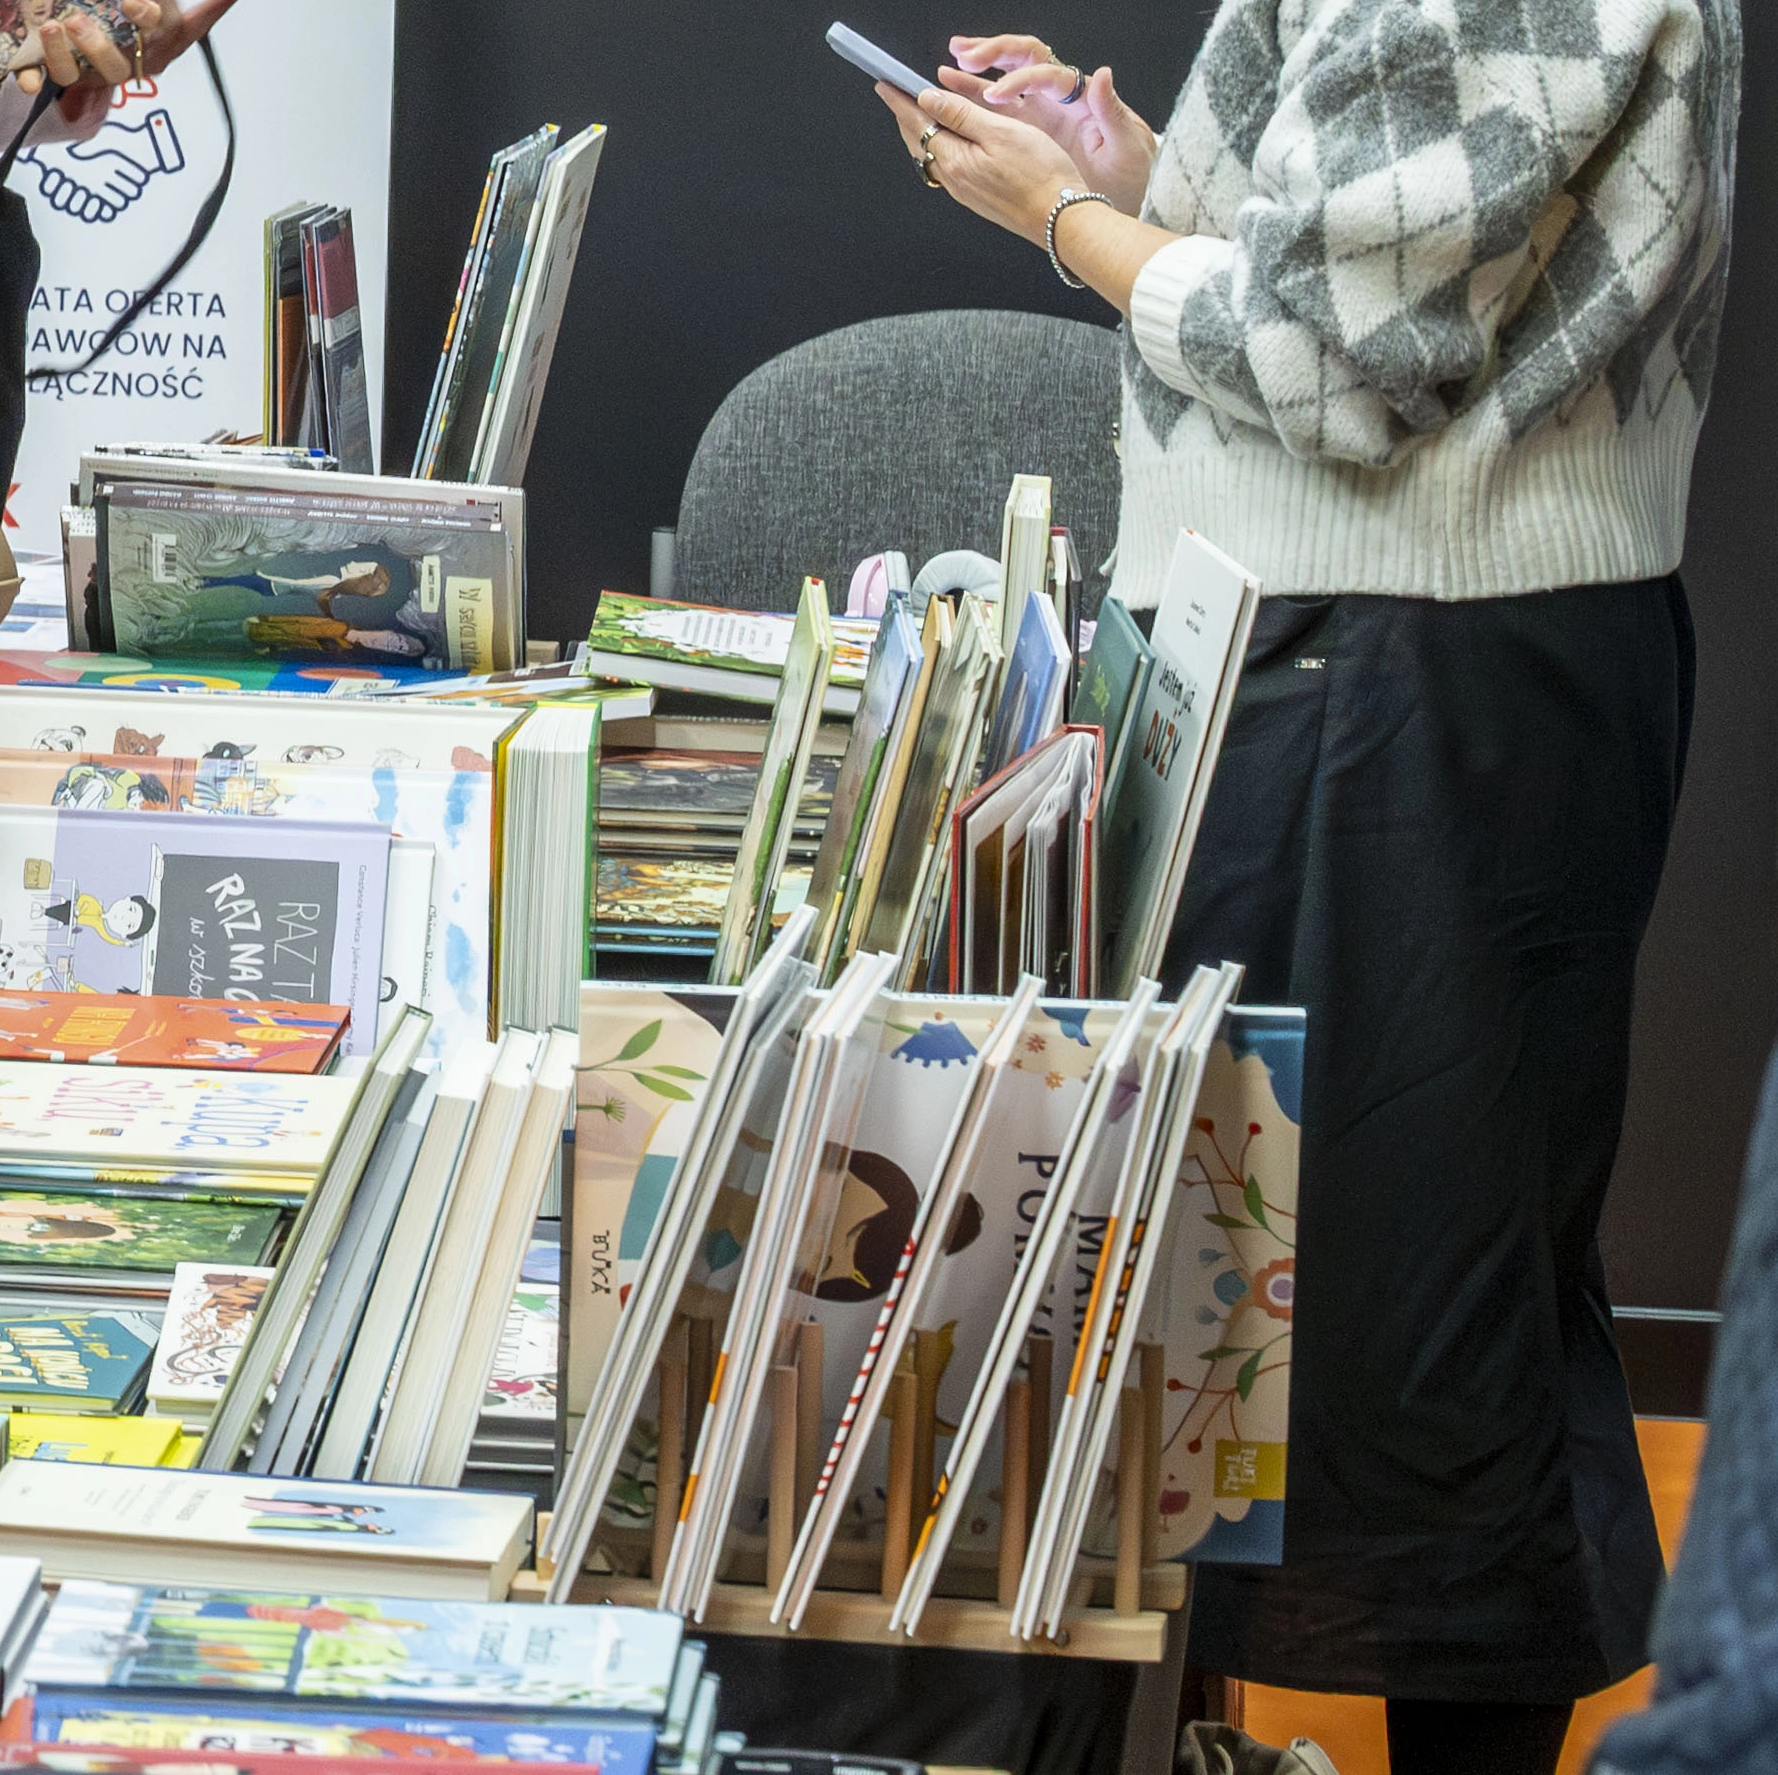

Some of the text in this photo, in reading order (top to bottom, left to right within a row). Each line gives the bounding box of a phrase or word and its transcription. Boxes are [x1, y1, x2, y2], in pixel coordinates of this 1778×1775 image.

[30, 286, 93, 313] ATA
[182, 332, 227, 359] NA
[204, 872, 264, 941] RAZ
[273, 902, 321, 966] RAZ
[227, 943, 266, 982] NA
[591, 1229, 612, 1295] BUKA
